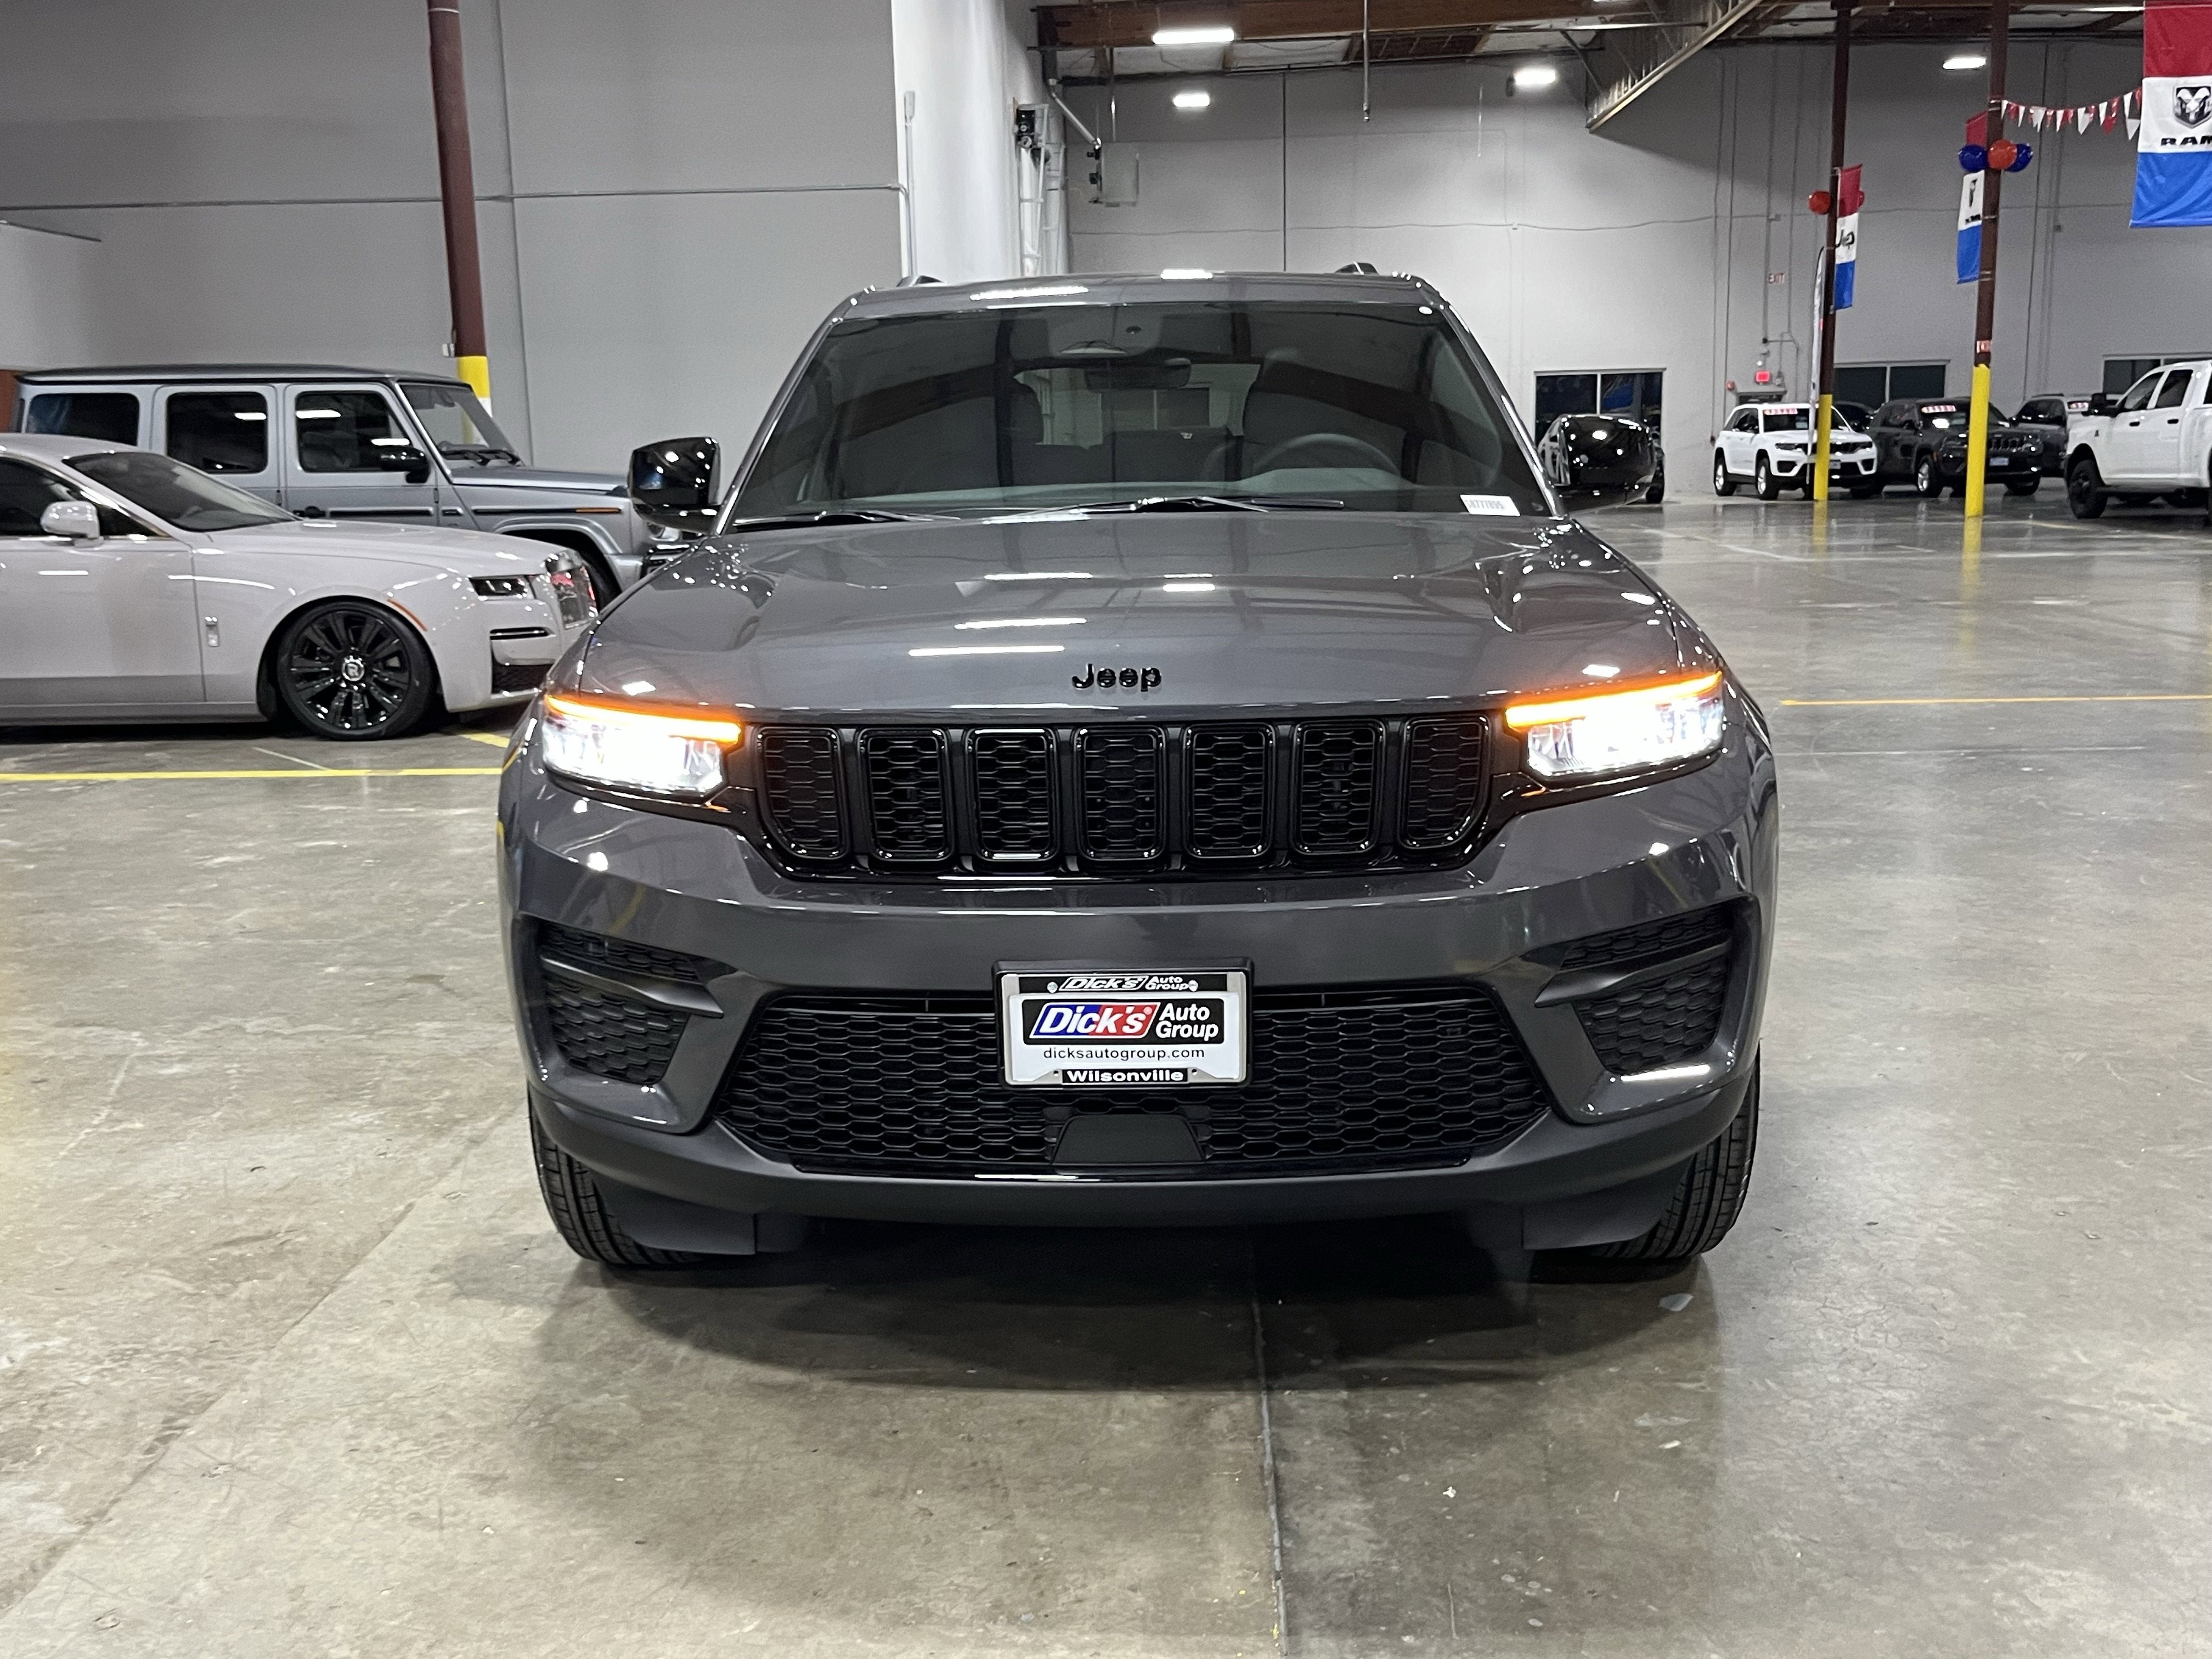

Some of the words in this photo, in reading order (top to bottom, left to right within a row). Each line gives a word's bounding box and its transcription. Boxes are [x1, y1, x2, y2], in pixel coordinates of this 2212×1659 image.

[2161, 136, 2212, 146] RAM
[1072, 663, 1161, 692] Jeep
[1065, 977, 1139, 989] Dick's
[1145, 983, 1189, 991] Group
[1159, 1003, 1210, 1021] Auto
[1039, 1006, 1147, 1034] Dick's
[1155, 1020, 1219, 1041] Group
[1043, 1047, 1205, 1061] dicksautogroup.com
[1066, 1069, 1184, 1082] Wilsonville
